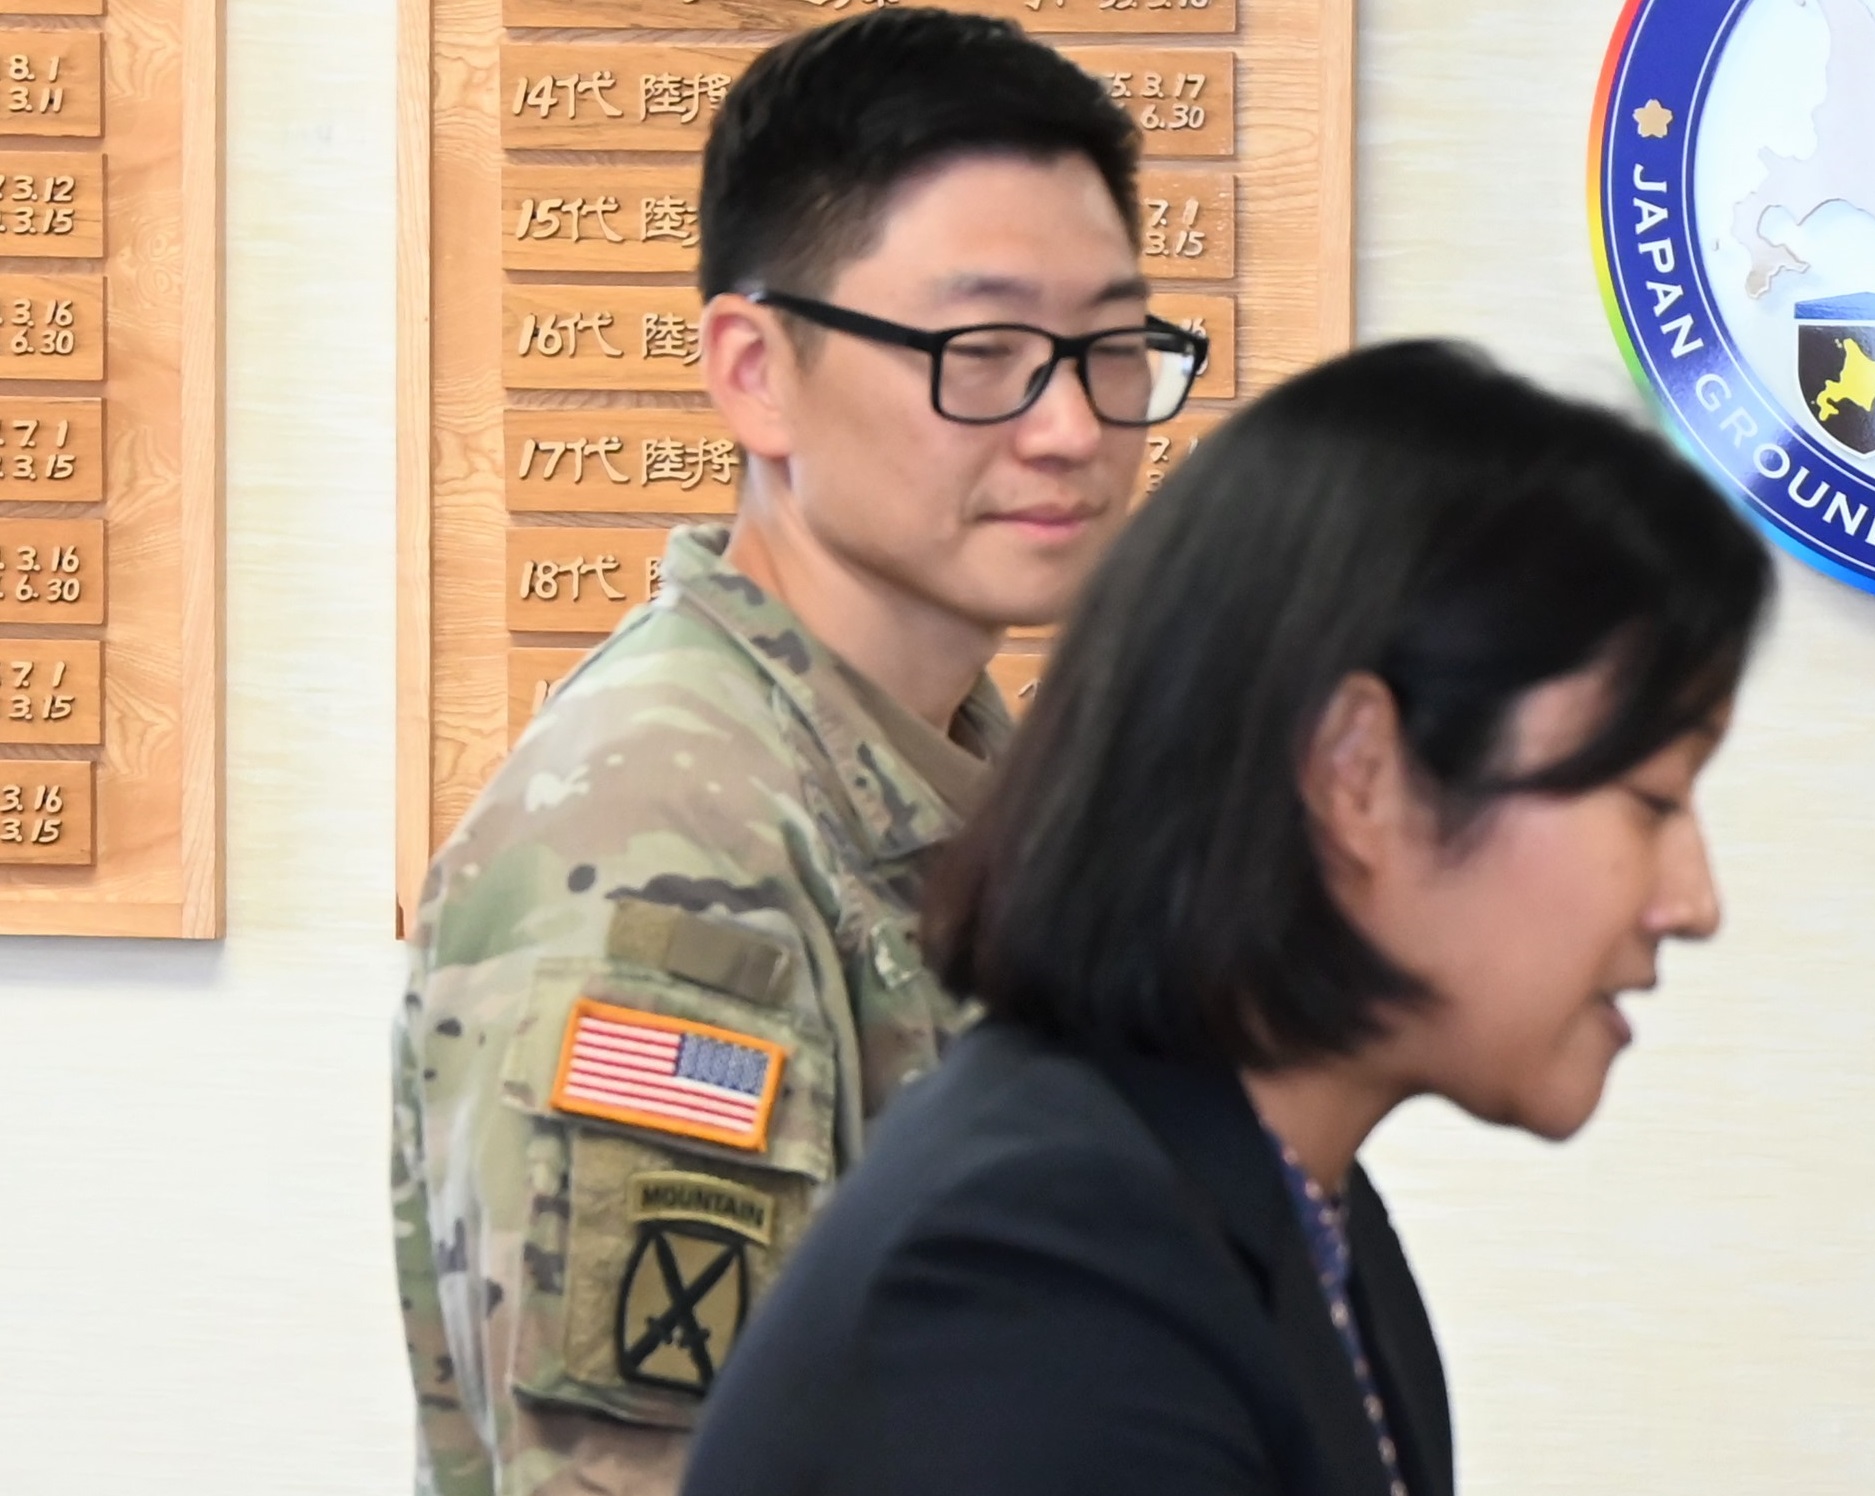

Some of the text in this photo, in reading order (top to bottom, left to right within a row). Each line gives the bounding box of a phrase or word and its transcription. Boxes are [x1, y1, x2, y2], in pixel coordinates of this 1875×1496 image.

[512, 71, 624, 120] 14代
[515, 196, 625, 244] 15代
[1632, 163, 1704, 362] JAPAN
[518, 310, 625, 358] 16代
[518, 436, 630, 484] 17代
[520, 554, 627, 603] 18代
[641, 1182, 766, 1229] MOUNTAIN
